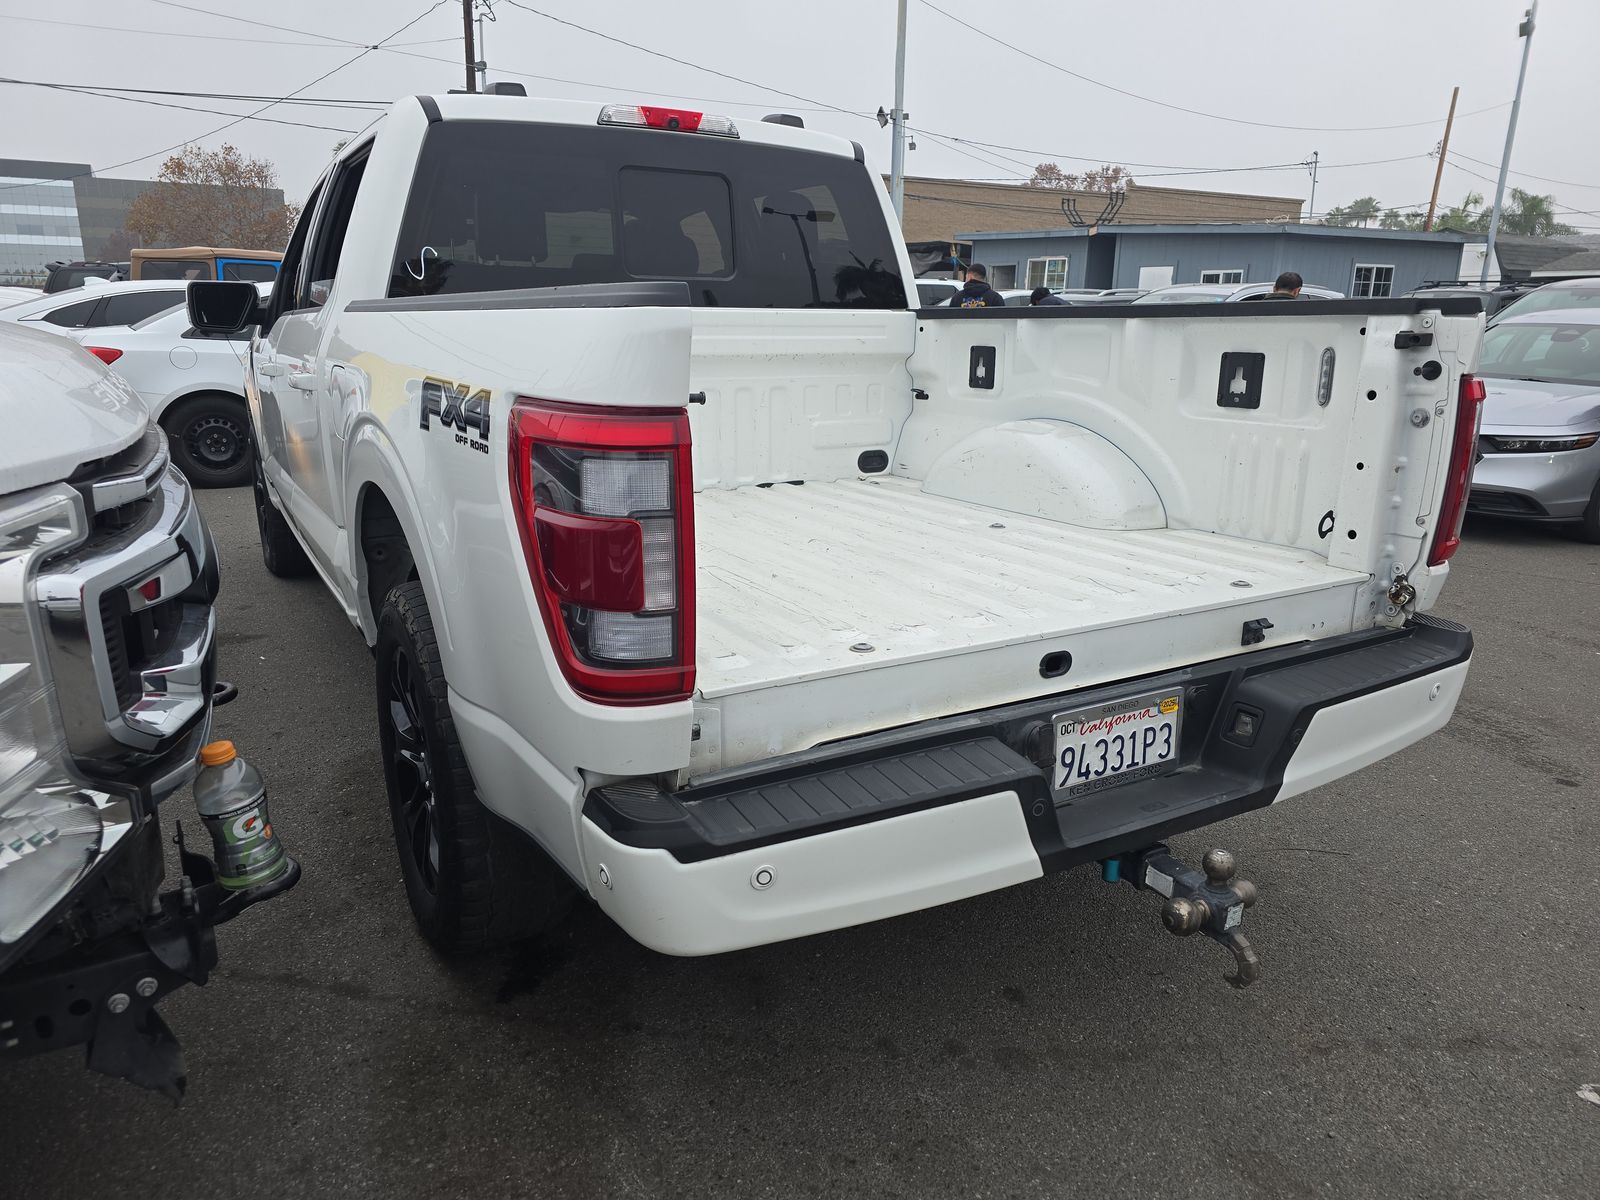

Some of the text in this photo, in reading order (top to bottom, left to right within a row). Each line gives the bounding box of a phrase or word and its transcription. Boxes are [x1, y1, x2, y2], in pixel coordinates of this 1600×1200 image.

[420, 375, 492, 442] FX4
[455, 433, 489, 454] OFF ROAD
[1102, 700, 1139, 714] SAN DIEGO
[1060, 722, 1076, 736] OCT
[1079, 708, 1158, 736] California
[1059, 722, 1172, 788] 94331P3
[1069, 764, 1162, 797] KEN GRODY FORD
